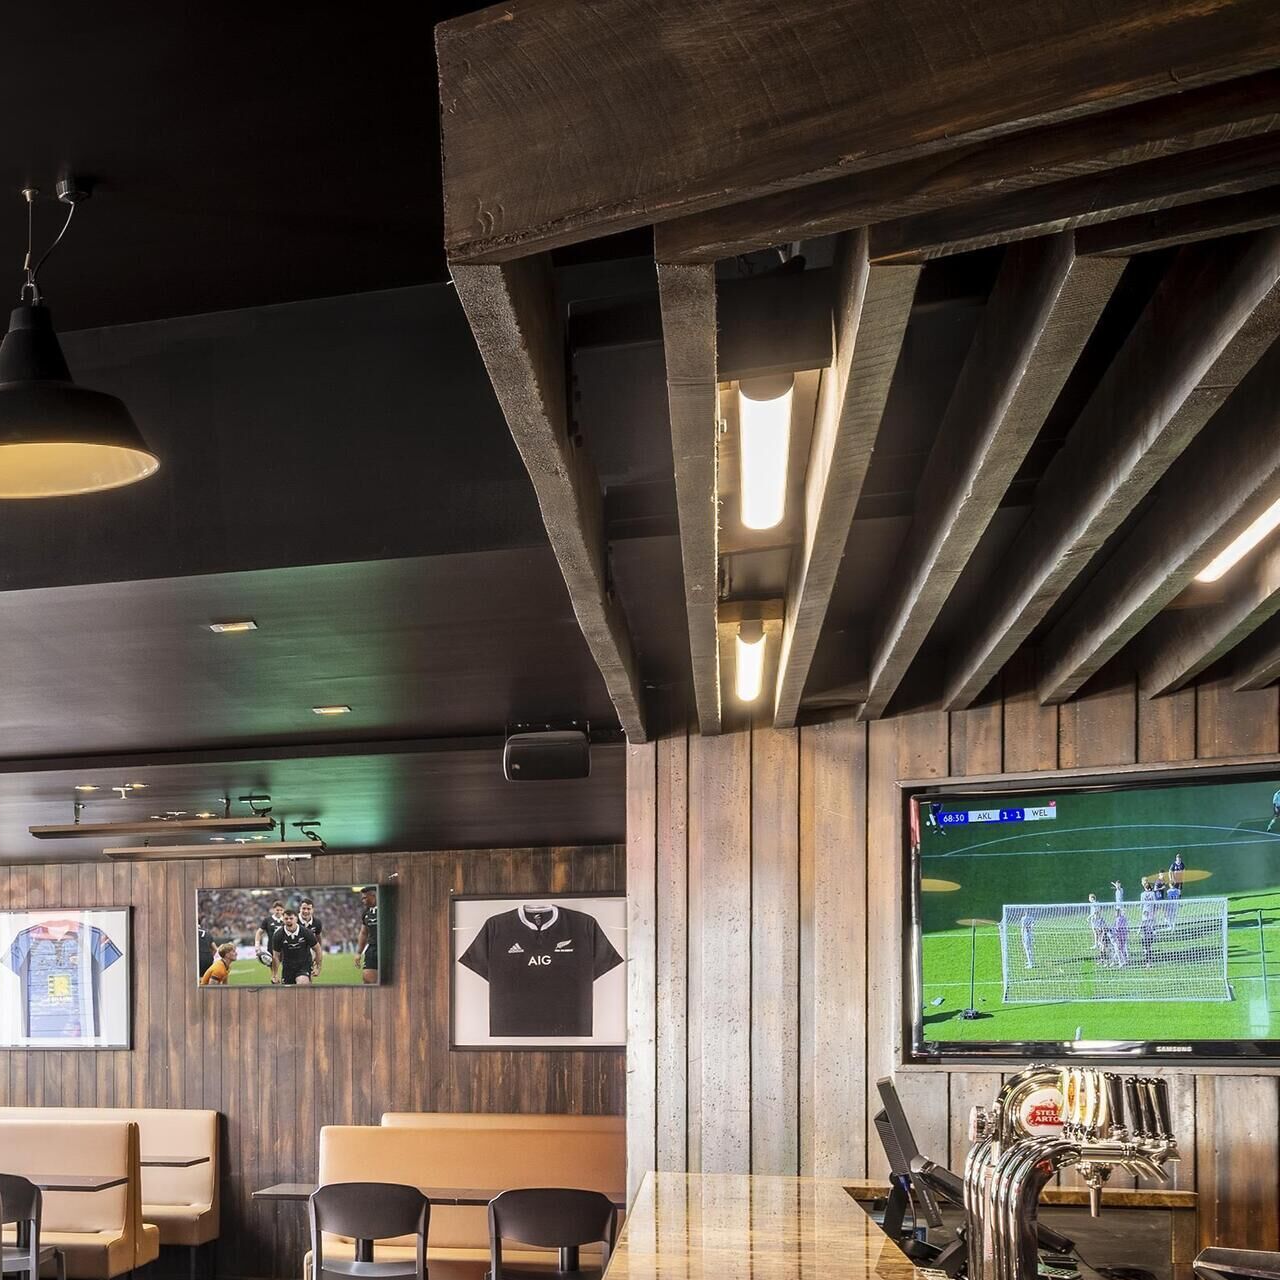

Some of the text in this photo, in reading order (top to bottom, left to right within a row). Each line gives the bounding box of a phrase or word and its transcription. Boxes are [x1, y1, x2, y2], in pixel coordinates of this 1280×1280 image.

[977, 812, 992, 820] AKL
[1031, 808, 1048, 817] WEL
[528, 955, 552, 966] AIG
